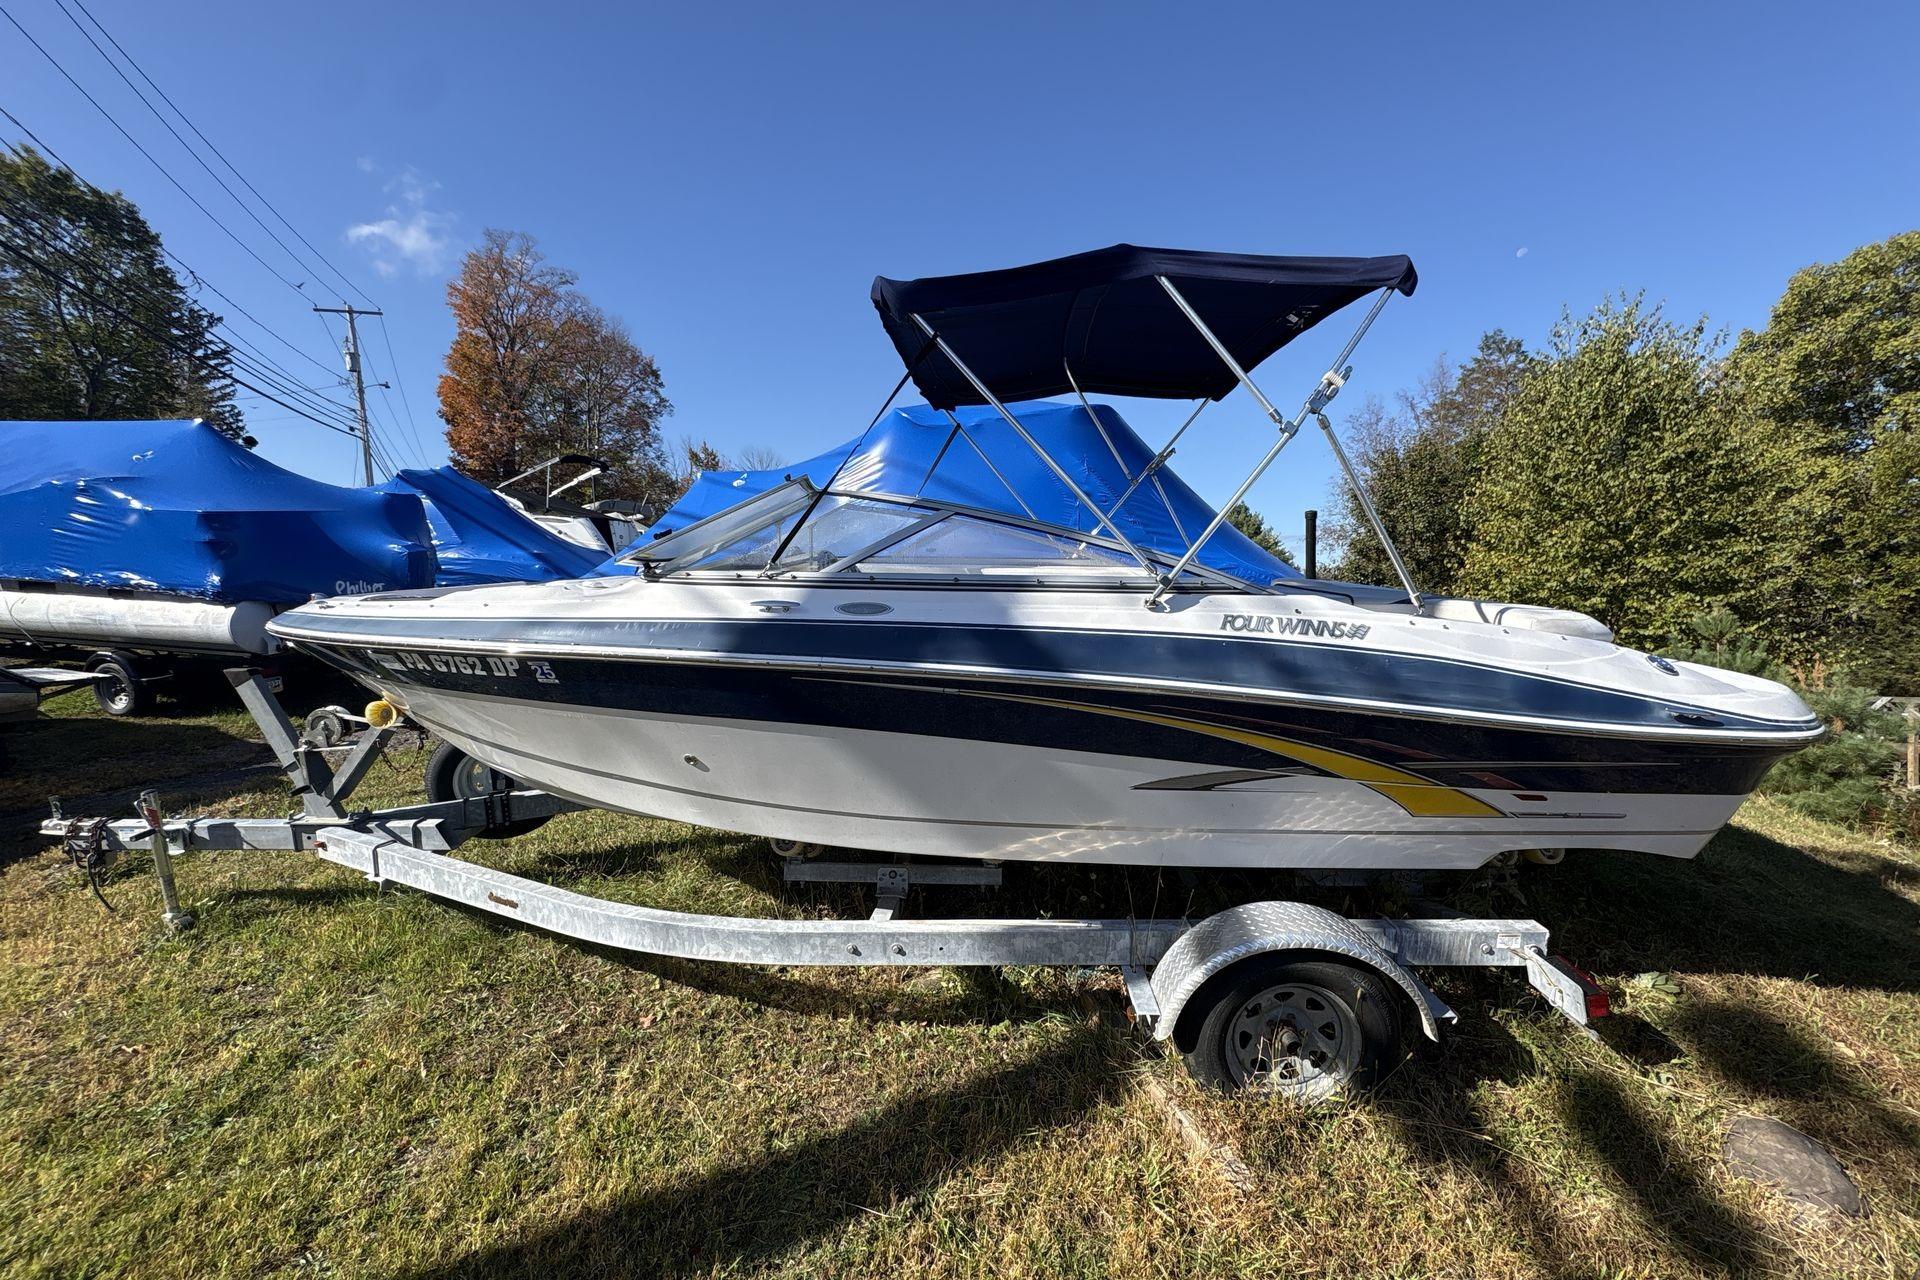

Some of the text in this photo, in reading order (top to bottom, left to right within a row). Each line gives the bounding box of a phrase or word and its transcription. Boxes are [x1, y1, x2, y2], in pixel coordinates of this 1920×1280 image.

[1220, 614, 1347, 639] FOUR WINNS
[397, 651, 520, 677] PA 6762 DP
[531, 665, 556, 679] 25
